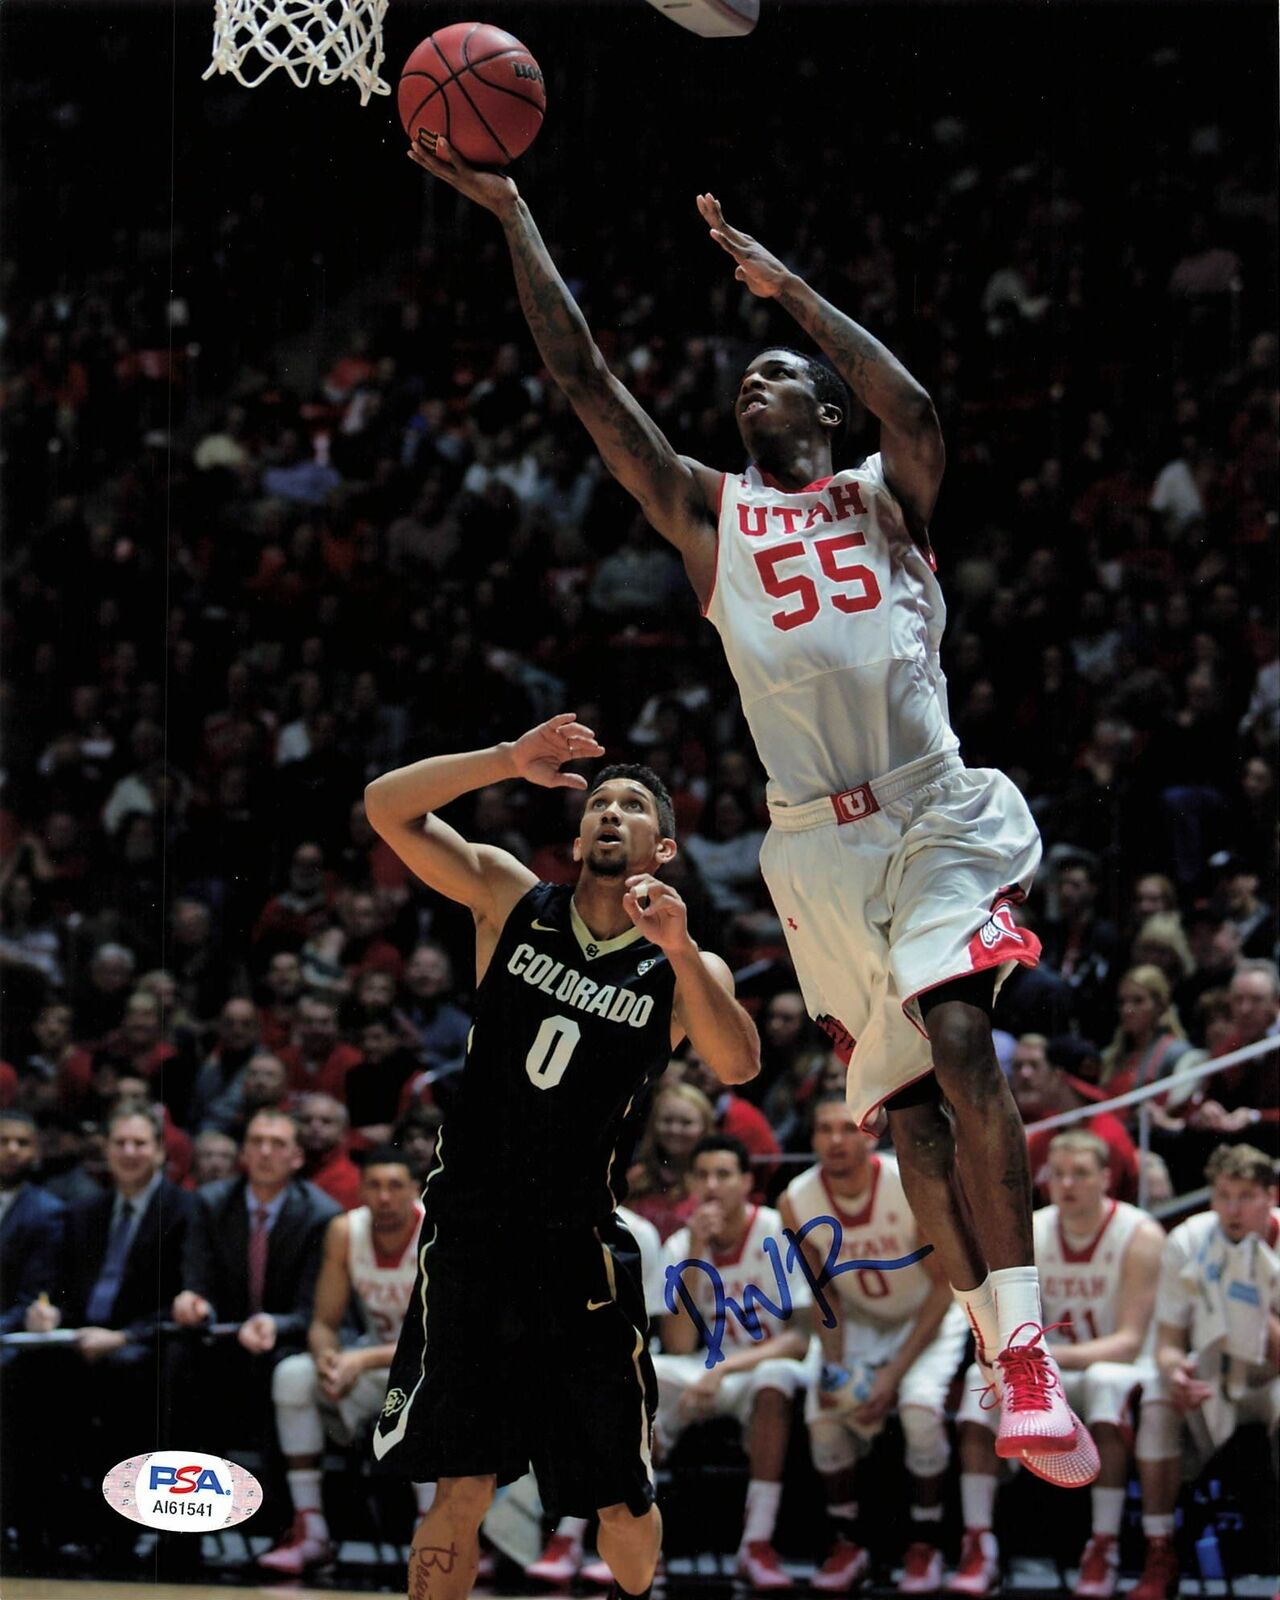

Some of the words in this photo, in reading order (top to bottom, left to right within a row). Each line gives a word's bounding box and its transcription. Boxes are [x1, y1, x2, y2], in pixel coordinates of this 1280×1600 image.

[736, 481, 868, 537] UTAH
[752, 531, 883, 632] 55
[507, 943, 655, 1028] COLORADO
[525, 1014, 581, 1090] 0
[152, 1500, 213, 1517] AI61541
